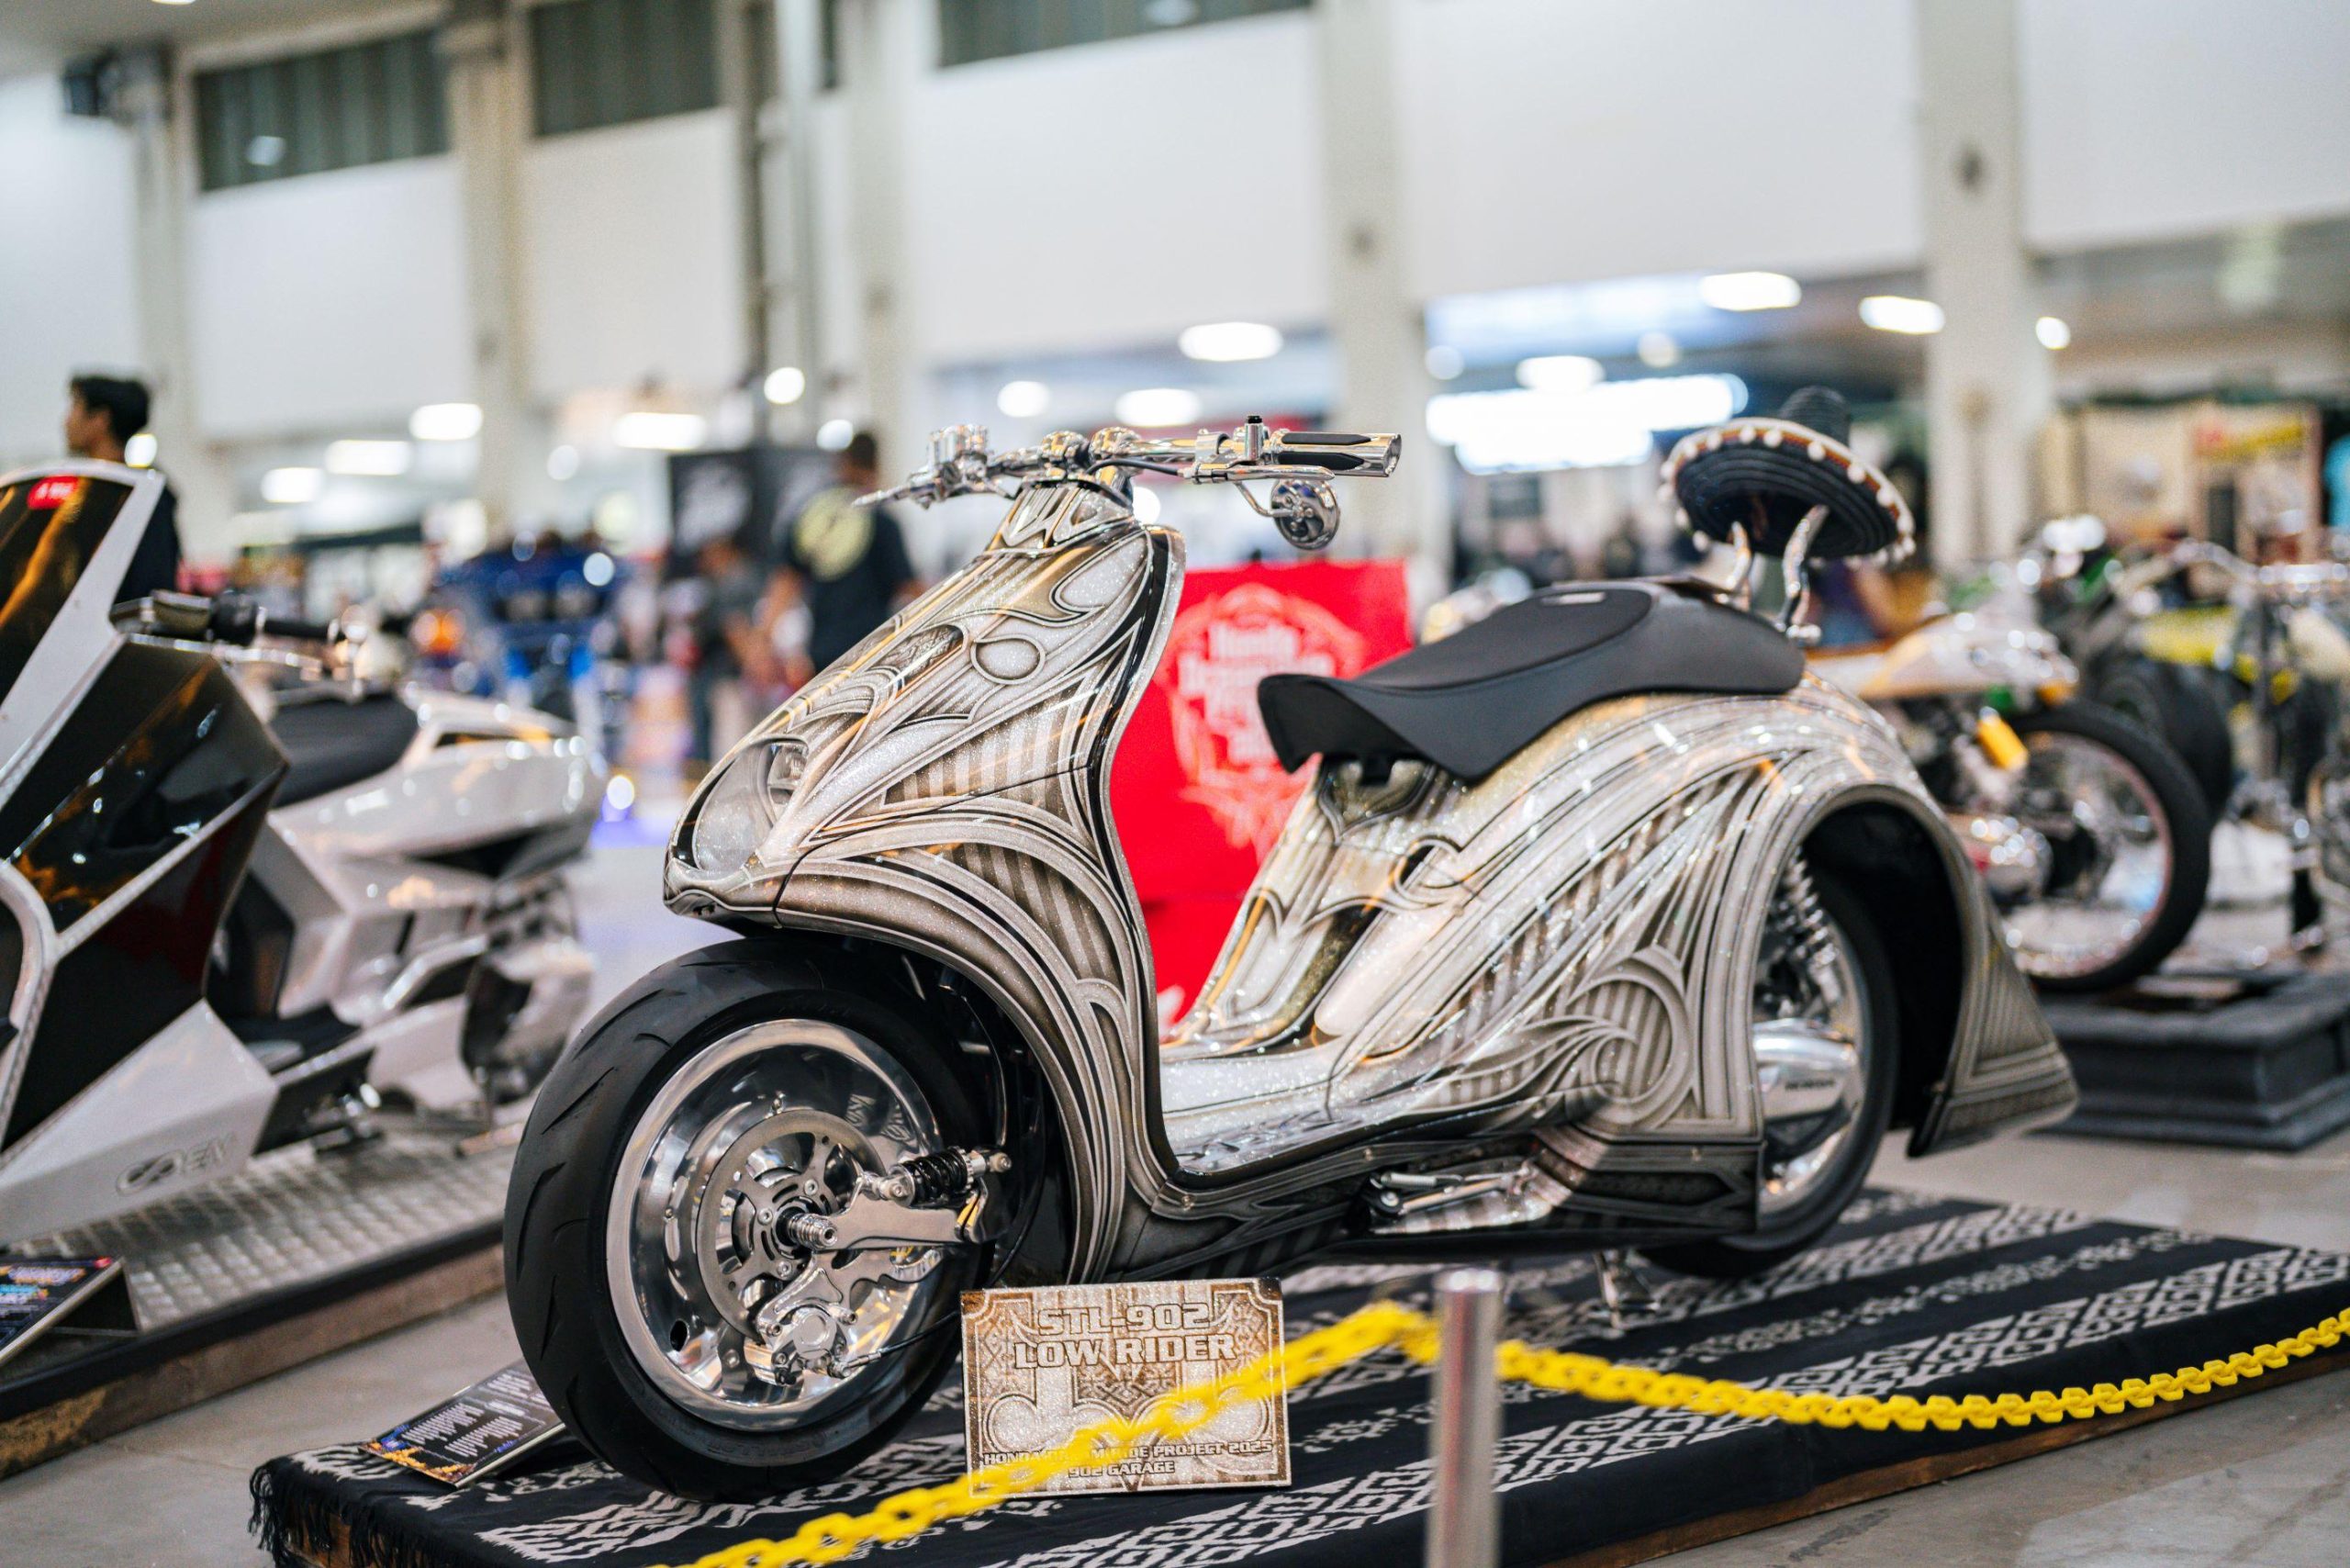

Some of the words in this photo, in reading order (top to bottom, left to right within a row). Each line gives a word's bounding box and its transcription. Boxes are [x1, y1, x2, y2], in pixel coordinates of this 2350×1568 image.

[1037, 1302, 1210, 1336] STL-902
[1014, 1338, 1102, 1369] LOW
[1114, 1333, 1237, 1365] RIDER
[1153, 1442, 1224, 1458] PROJECT
[1228, 1440, 1273, 1454] 2025
[1069, 1464, 1103, 1478] 902
[1107, 1461, 1176, 1477] GARAGE
